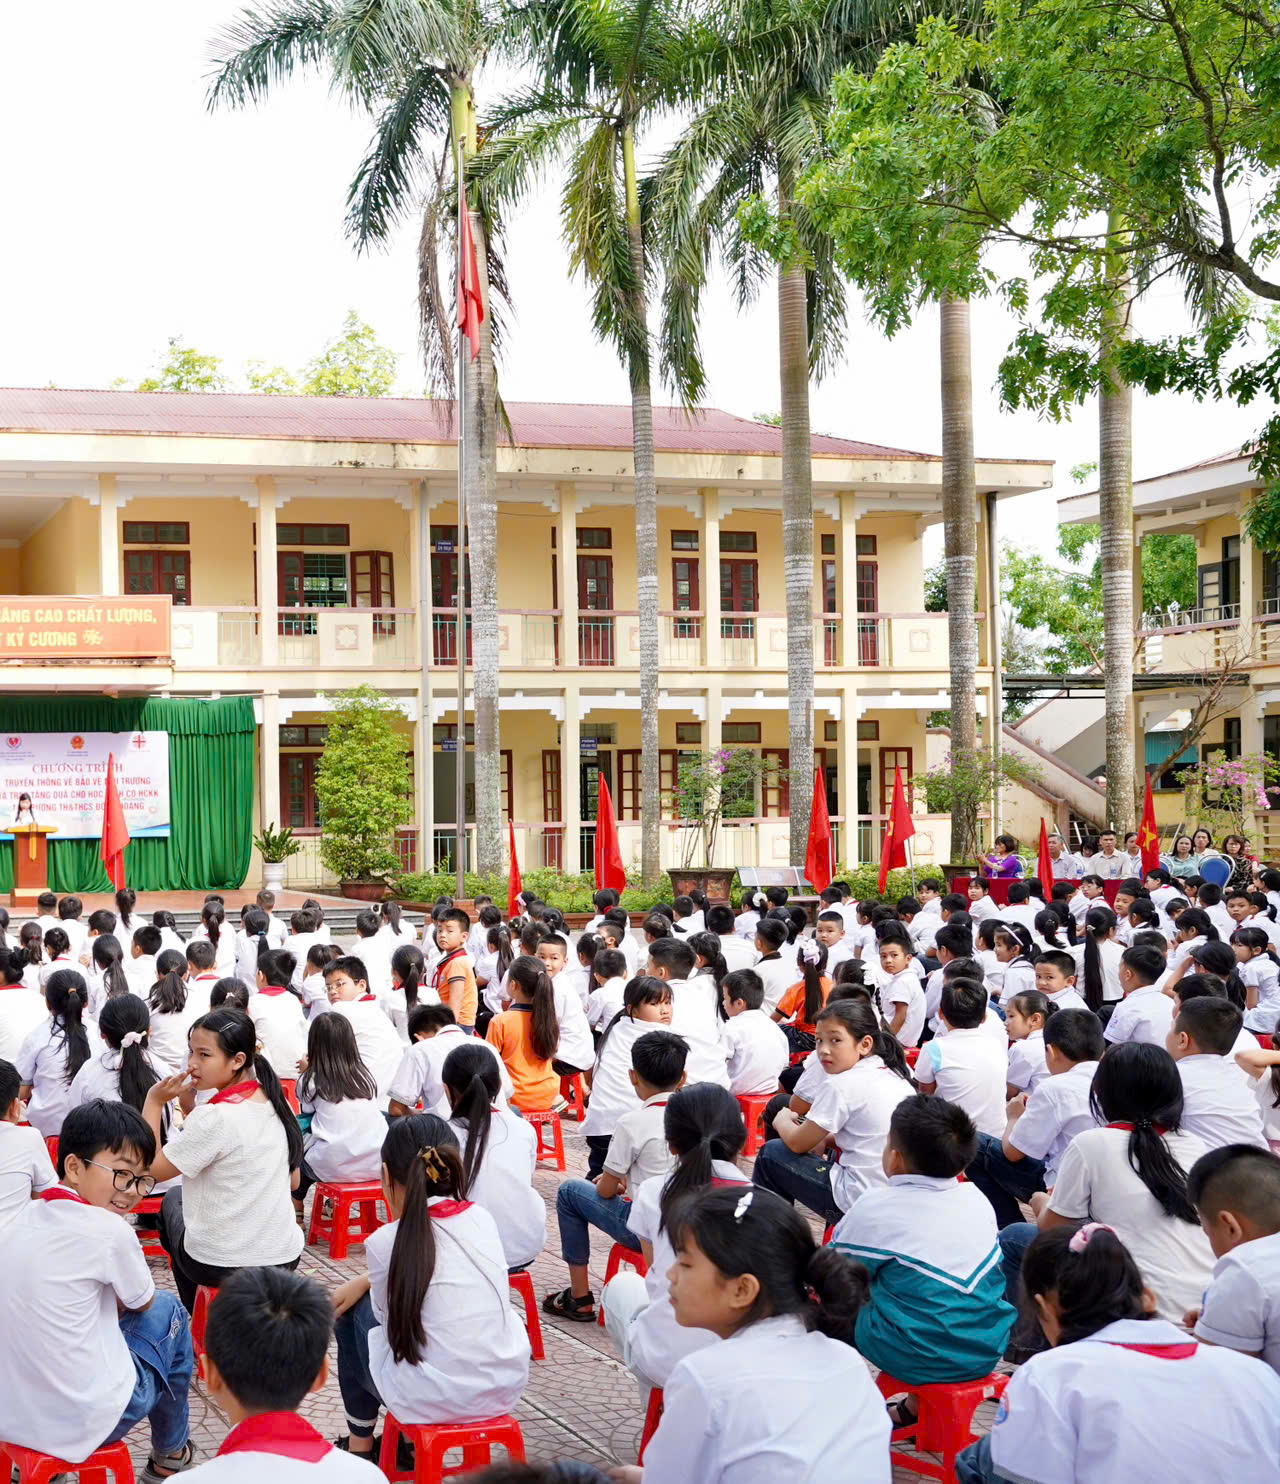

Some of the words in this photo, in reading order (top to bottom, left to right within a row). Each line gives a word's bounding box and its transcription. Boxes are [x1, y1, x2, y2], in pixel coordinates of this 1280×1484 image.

[34, 609, 63, 623] CAO
[67, 604, 103, 623] CHẤT
[107, 607, 157, 625] LƯỢNG,
[28, 630, 77, 647] CƯƠNG
[32, 762, 83, 773] CHƯƠNG
